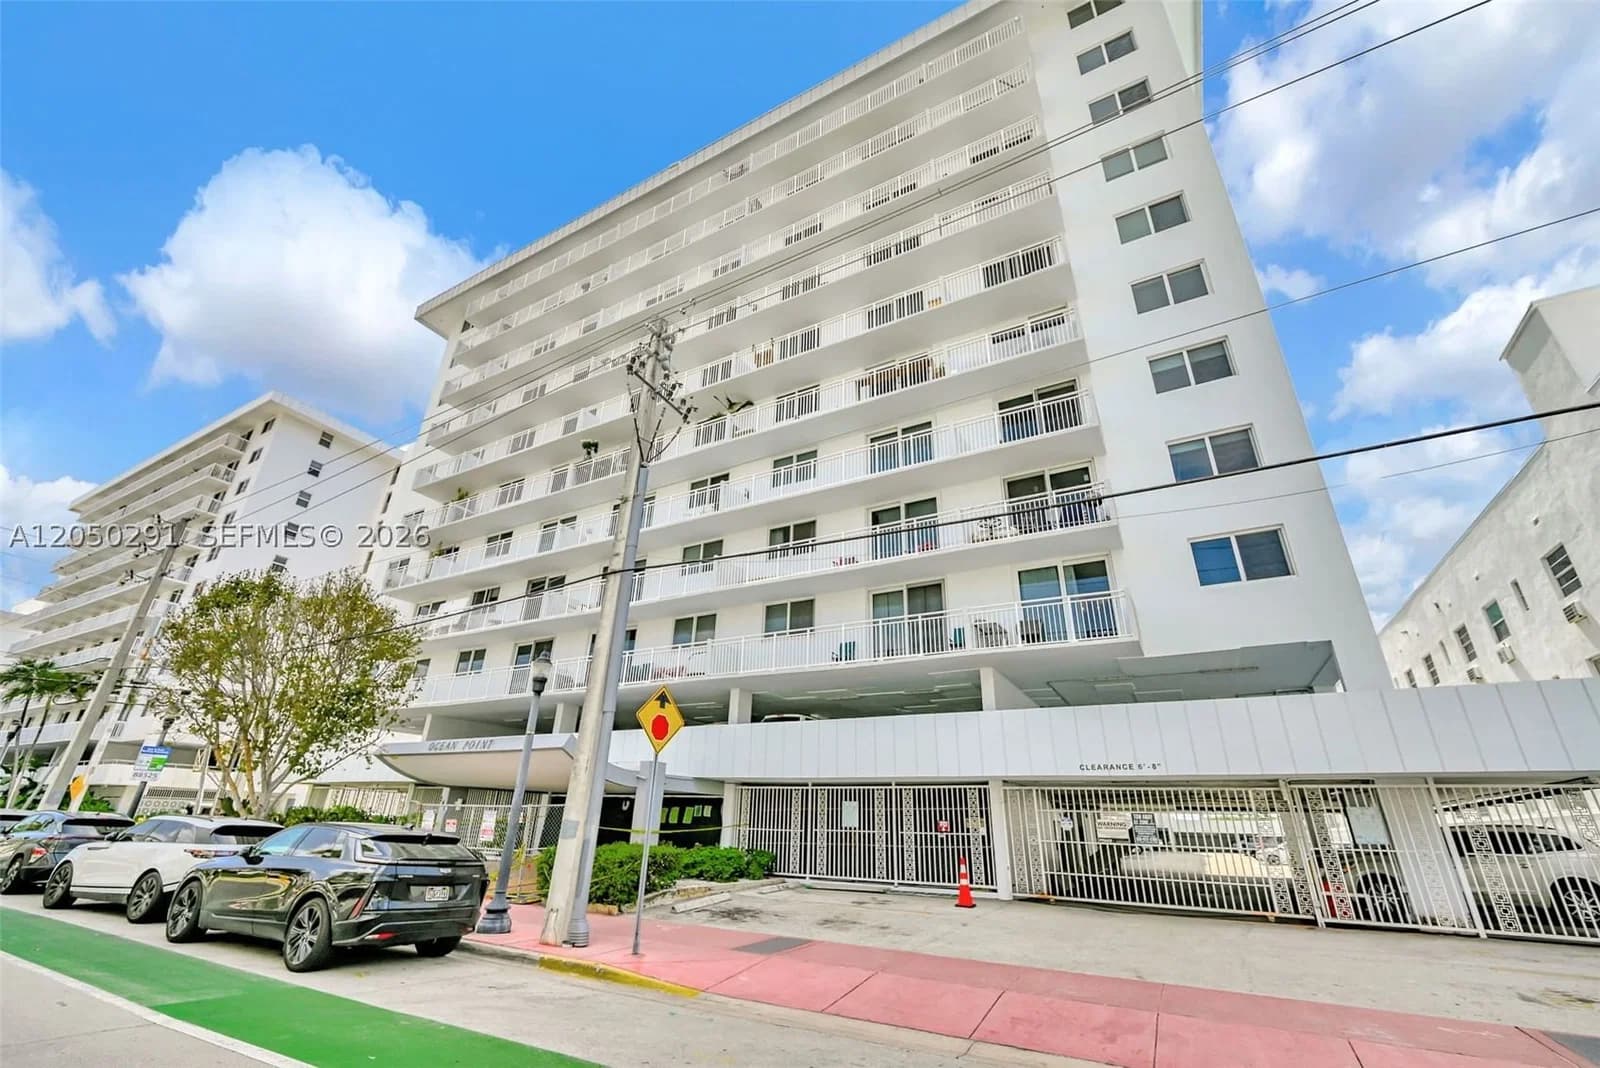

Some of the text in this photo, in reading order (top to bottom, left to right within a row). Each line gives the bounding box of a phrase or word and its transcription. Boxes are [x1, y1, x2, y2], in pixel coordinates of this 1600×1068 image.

[428, 739, 494, 752] OCEAN POINT
[1079, 763, 1134, 771] CLEARANCE
